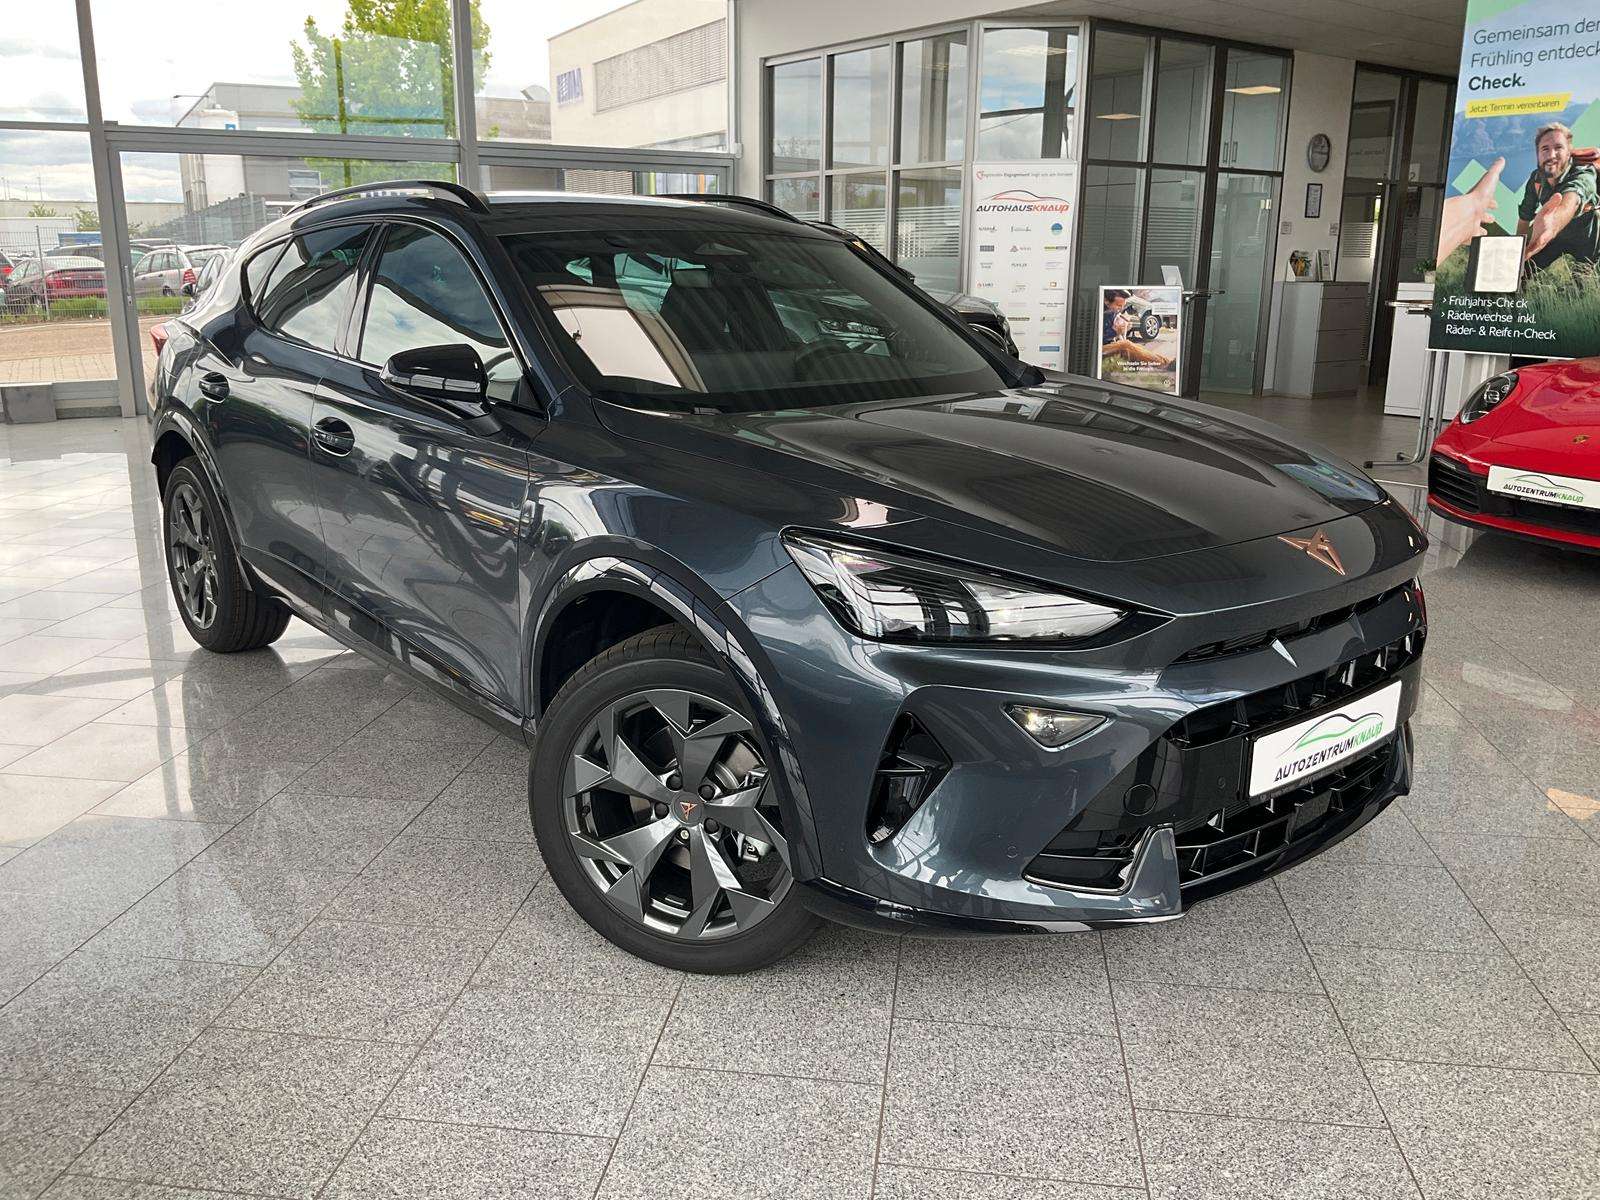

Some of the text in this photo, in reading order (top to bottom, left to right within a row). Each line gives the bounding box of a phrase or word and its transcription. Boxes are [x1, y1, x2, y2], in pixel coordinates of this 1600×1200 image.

[1473, 23, 1569, 45] Gemeinsam
[1471, 49, 1534, 68] Frühling
[1468, 73, 1526, 91] Check.
[1469, 100, 1560, 113] Jetzt Termin vereinbaren
[1447, 309, 1537, 324] Räderwechse inkl.
[1445, 324, 1477, 336] Räder-
[1478, 325, 1486, 336] &
[1274, 721, 1384, 782] AUTOZENTRUMKNAUP
